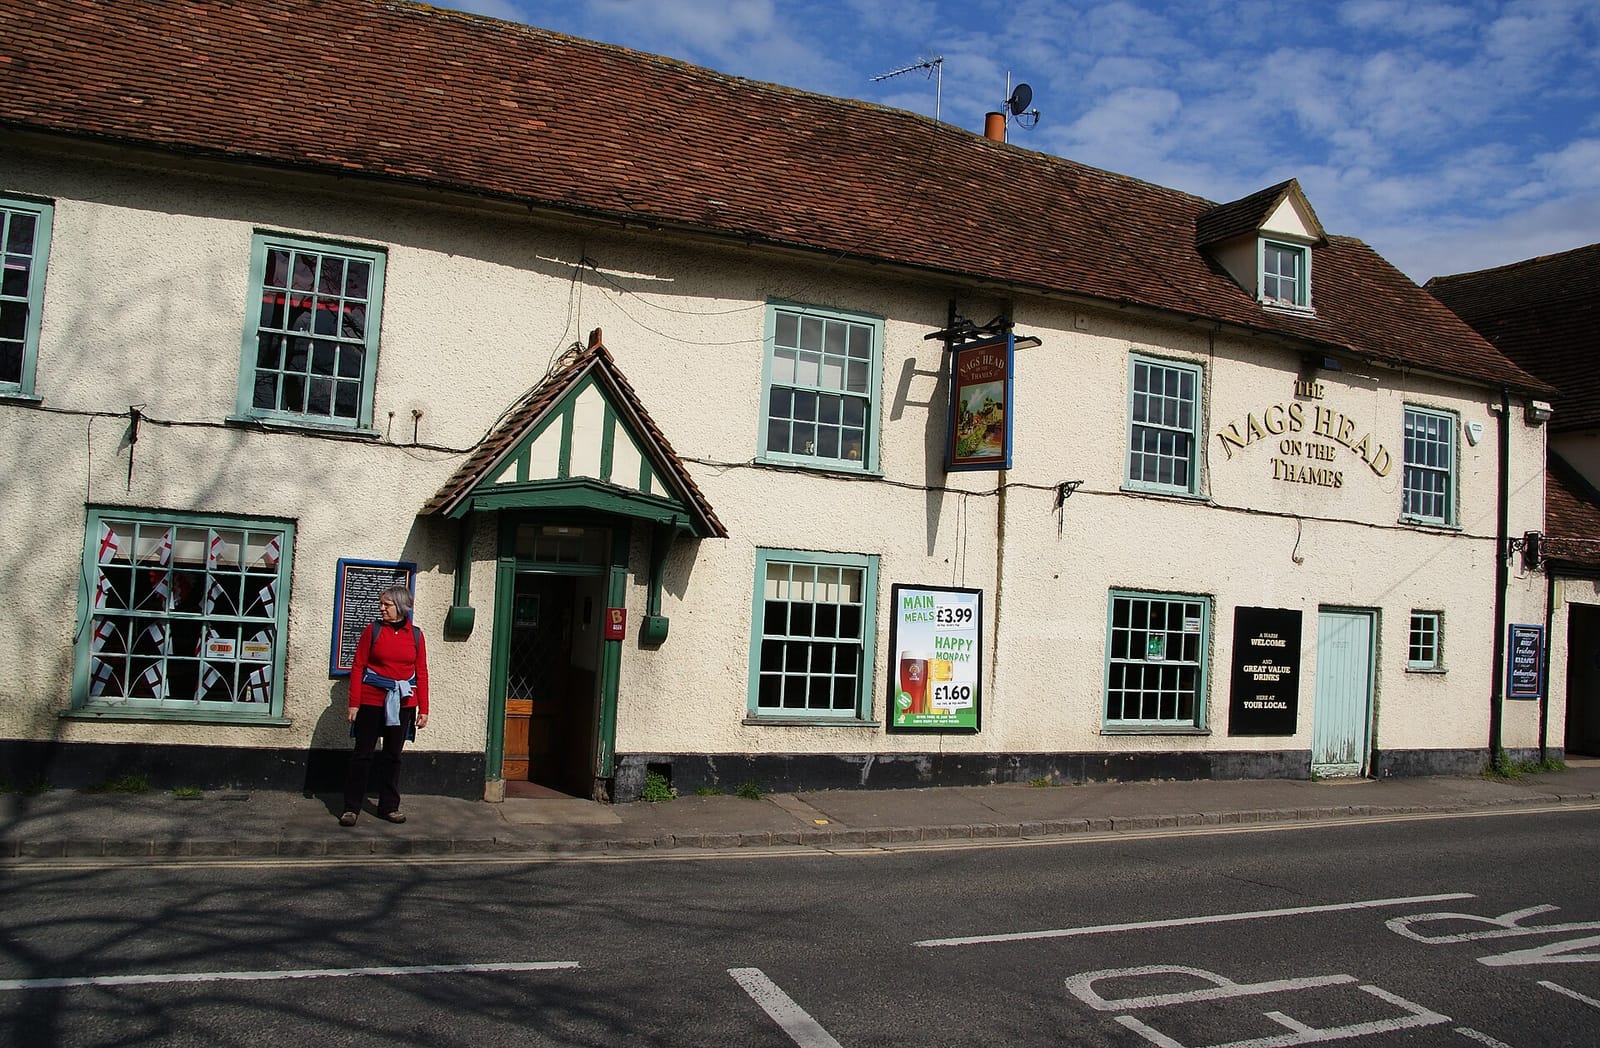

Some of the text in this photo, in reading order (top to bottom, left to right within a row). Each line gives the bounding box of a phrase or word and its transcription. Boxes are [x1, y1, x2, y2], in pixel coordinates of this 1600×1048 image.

[960, 355, 1004, 376] NAGS HEAD
[1294, 380, 1324, 400] THE
[1216, 402, 1392, 477] NAGS HEAD
[1280, 439, 1335, 462] ON THE
[1270, 458, 1343, 488] THAMES
[904, 596, 934, 609] MAIN
[905, 612, 935, 622] MEALS
[936, 608, 972, 623] £3.99
[935, 636, 973, 651] HAPPY
[1251, 639, 1286, 647] WELCOME
[935, 652, 970, 662] MONDAY
[1516, 647, 1535, 657] Friday
[935, 686, 970, 701] £1.60
